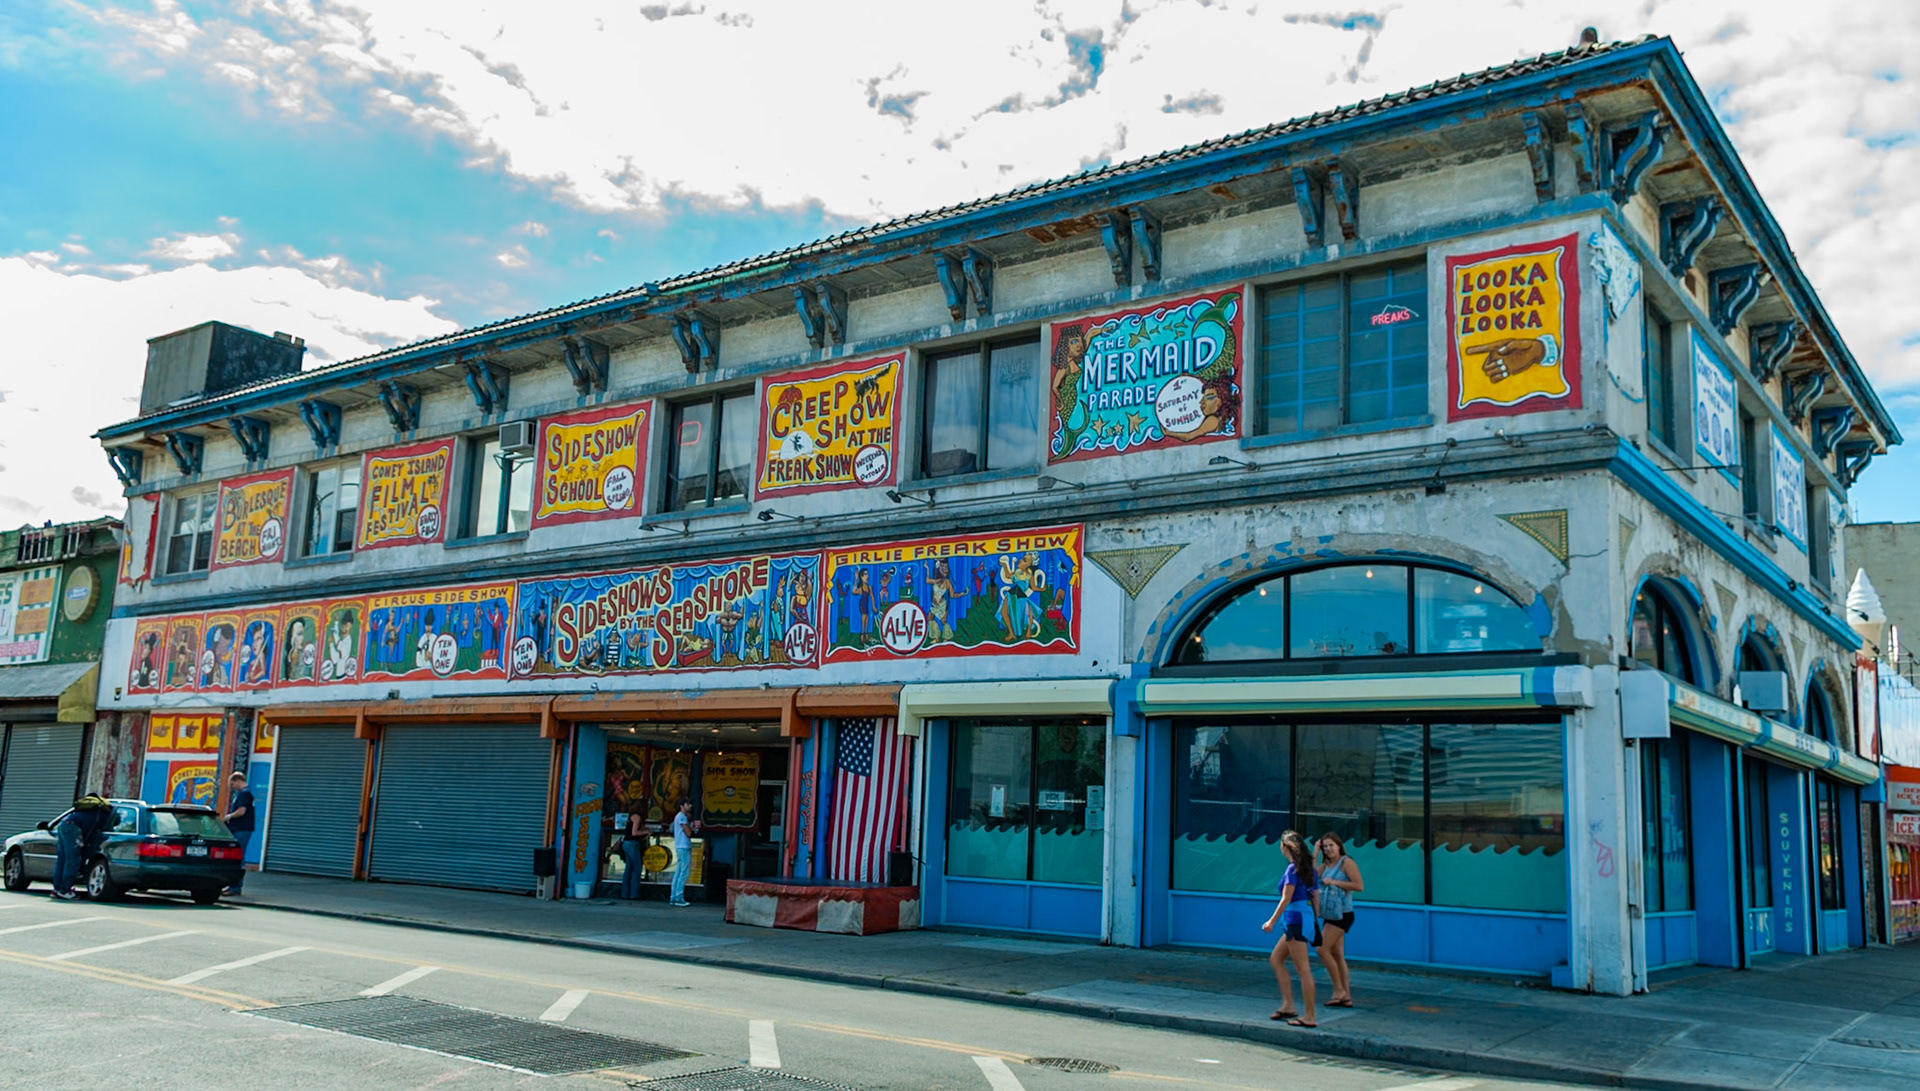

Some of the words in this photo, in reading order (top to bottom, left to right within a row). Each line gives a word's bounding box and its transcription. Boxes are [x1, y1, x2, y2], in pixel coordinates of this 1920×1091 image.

[1462, 263, 1548, 294] LOOKA
[1461, 287, 1544, 316] LOOKA
[1371, 309, 1411, 326] FREAKS
[1462, 311, 1543, 335] LOOKA
[1093, 336, 1125, 351] THE
[1082, 336, 1218, 393] MERMAID
[772, 381, 848, 439] CREEP
[1088, 385, 1157, 413] PARADE
[1158, 390, 1200, 413] SATURDAY
[815, 391, 890, 448] SHOW
[1165, 410, 1201, 428] SUMMER
[549, 415, 640, 471] SIDESHOW
[847, 430, 865, 448] AT
[869, 426, 891, 443] THE
[372, 463, 404, 479] CONEY
[407, 454, 445, 475] ISLAND
[768, 458, 814, 482] FREAK
[816, 454, 852, 480] SHOW
[866, 461, 874, 471] IN
[547, 474, 602, 505] SCHOOL
[606, 472, 627, 488] FALL
[222, 481, 287, 531] BURLESQUE
[369, 477, 415, 519] FILM
[606, 488, 631, 505] SPRING
[366, 481, 429, 540] FESTIVAL
[235, 521, 246, 536] AT
[263, 525, 277, 539] FRI
[220, 538, 256, 559] BEACH
[836, 550, 902, 566] GIRLIE
[914, 541, 987, 559] FREAK
[996, 533, 1069, 553] SHOW
[374, 594, 426, 607] CIRCUS
[434, 591, 464, 603] SIDE
[469, 587, 508, 600] SHOW
[558, 567, 671, 664] SIDESHOWS
[619, 618, 634, 629] BY
[636, 615, 654, 629] THE
[653, 557, 769, 668] SEASHORE
[883, 609, 925, 645] ALIVE
[438, 639, 452, 648] TEN
[514, 641, 533, 654] TEN
[787, 625, 815, 659] ALIVE
[435, 658, 451, 669] ONE
[440, 650, 447, 658] IN
[516, 658, 533, 671] ONE
[707, 767, 725, 776] SIDE
[730, 767, 756, 776] SHOW
[1896, 822, 1914, 833] ICE
[1780, 813, 1793, 932] SOUVENIRS
